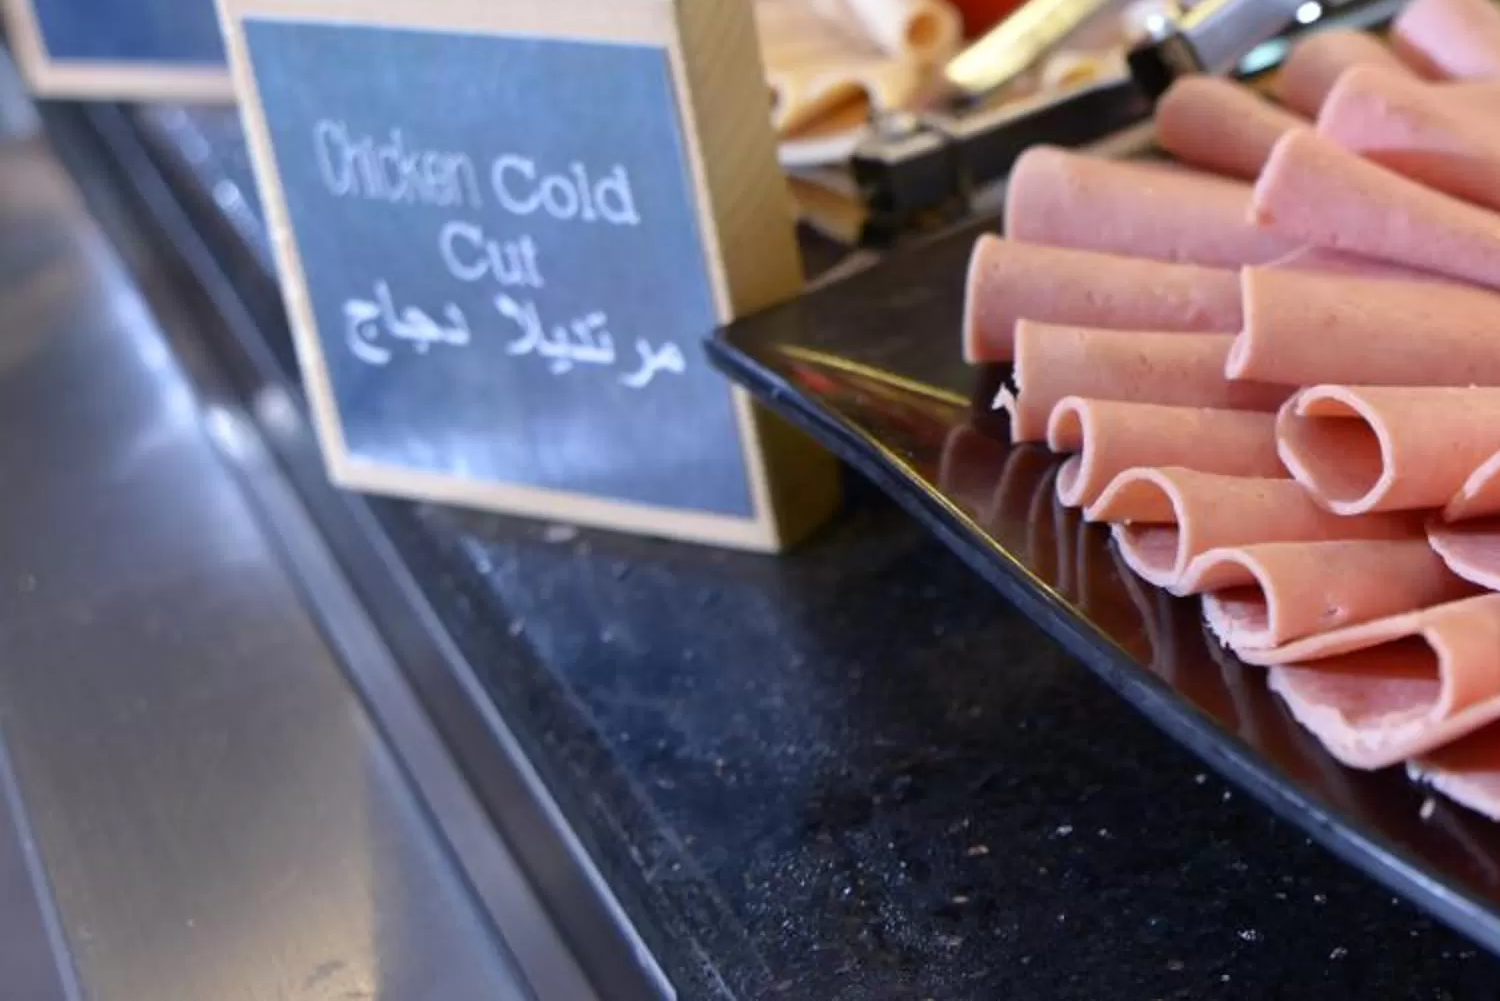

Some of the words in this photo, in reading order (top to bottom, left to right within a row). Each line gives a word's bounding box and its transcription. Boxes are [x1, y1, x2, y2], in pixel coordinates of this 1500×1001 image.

[314, 118, 482, 210] Chicken
[491, 153, 641, 225] Cold
[438, 219, 544, 288] Cut
[342, 278, 471, 366] دجاج
